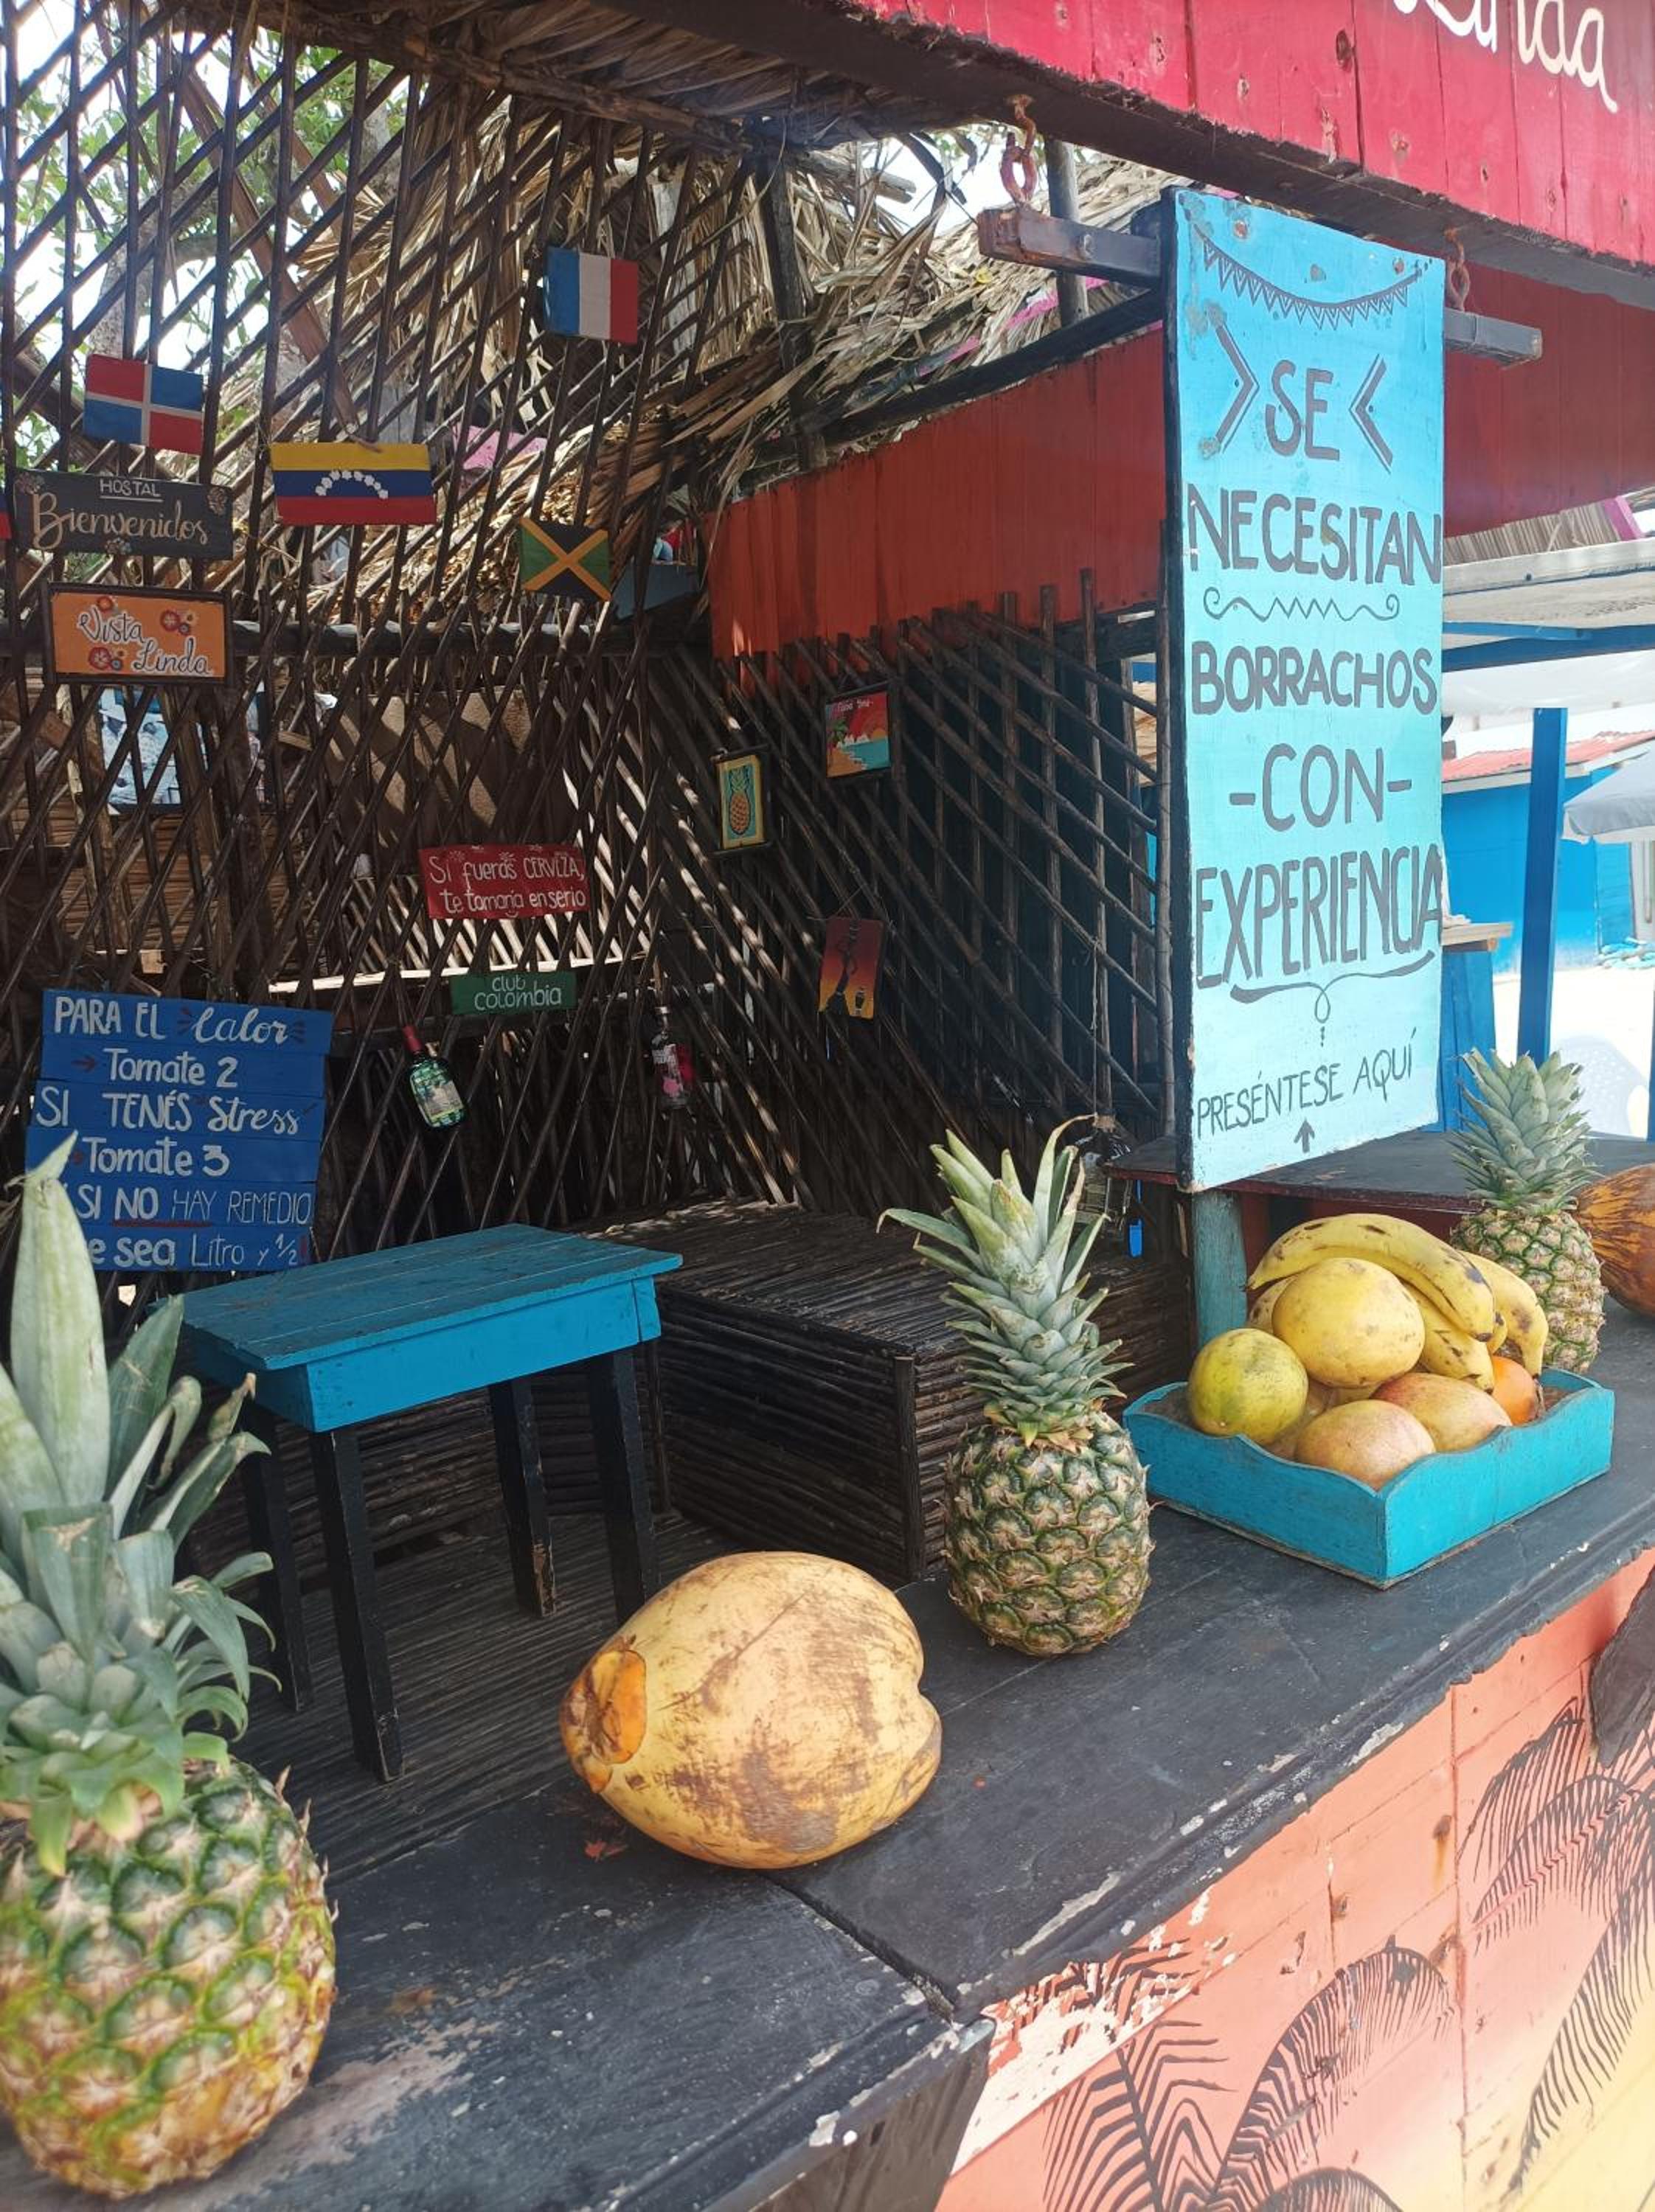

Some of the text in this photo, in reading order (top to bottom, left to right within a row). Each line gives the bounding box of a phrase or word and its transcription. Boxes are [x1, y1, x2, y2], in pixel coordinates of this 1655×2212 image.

[1265, 359, 1340, 462] SE
[100, 479, 161, 497] HOSTAL
[32, 492, 208, 550] Bienvenidos
[1188, 482, 1442, 585] NECESITAN
[78, 605, 146, 644] Vista
[133, 636, 213, 675] Linda
[1191, 640, 1437, 715] BORRACHOS
[429, 856, 451, 884] Si
[463, 859, 517, 891] fueras
[439, 888, 464, 914] te
[1196, 843, 1443, 989] EXPERIENCIA
[492, 975, 526, 992] club
[55, 996, 122, 1035] PARA
[135, 1002, 165, 1040] EL
[102, 1048, 238, 1088] Tomate 2
[1196, 1027, 1418, 1139] PRESÉNTESE AQUÍ
[35, 1086, 300, 1135] SI TENÉS Stress
[82, 1135, 230, 1178] Tomate 3
[76, 1183, 312, 1225] SI NO HAY REMEDIO
[113, 1237, 176, 1268] sea
[191, 1233, 244, 1267] Litro
